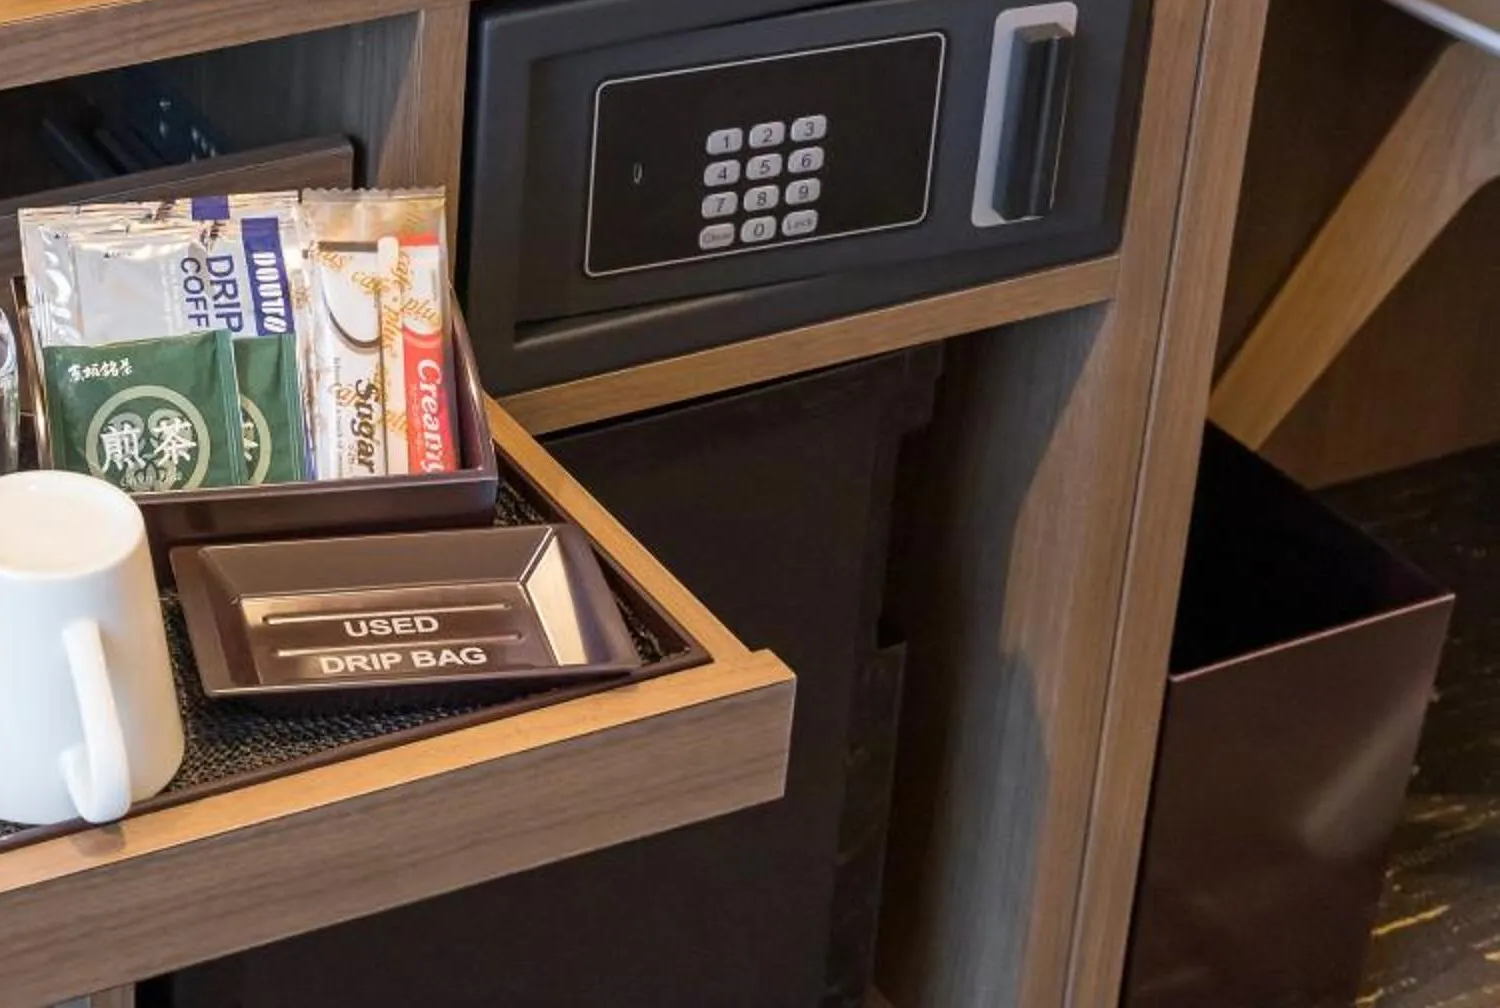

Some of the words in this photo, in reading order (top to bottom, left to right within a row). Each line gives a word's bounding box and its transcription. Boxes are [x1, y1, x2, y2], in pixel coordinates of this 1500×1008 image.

[762, 127, 773, 144] 2
[804, 121, 814, 137] 3
[717, 167, 727, 180] 4
[760, 159, 771, 175] 5
[801, 153, 812, 169] 6
[716, 196, 726, 212] 7
[756, 191, 767, 207] 8
[798, 184, 809, 201] 9
[754, 223, 765, 237] 0
[180, 257, 210, 328] COFF
[206, 255, 244, 333] DRIP
[252, 251, 288, 334] DOUTO
[351, 379, 379, 474] Sugar
[100, 416, 197, 476] 煎茶
[342, 615, 440, 638] USED
[319, 652, 403, 675] DRIP
[410, 646, 488, 669] BAG
